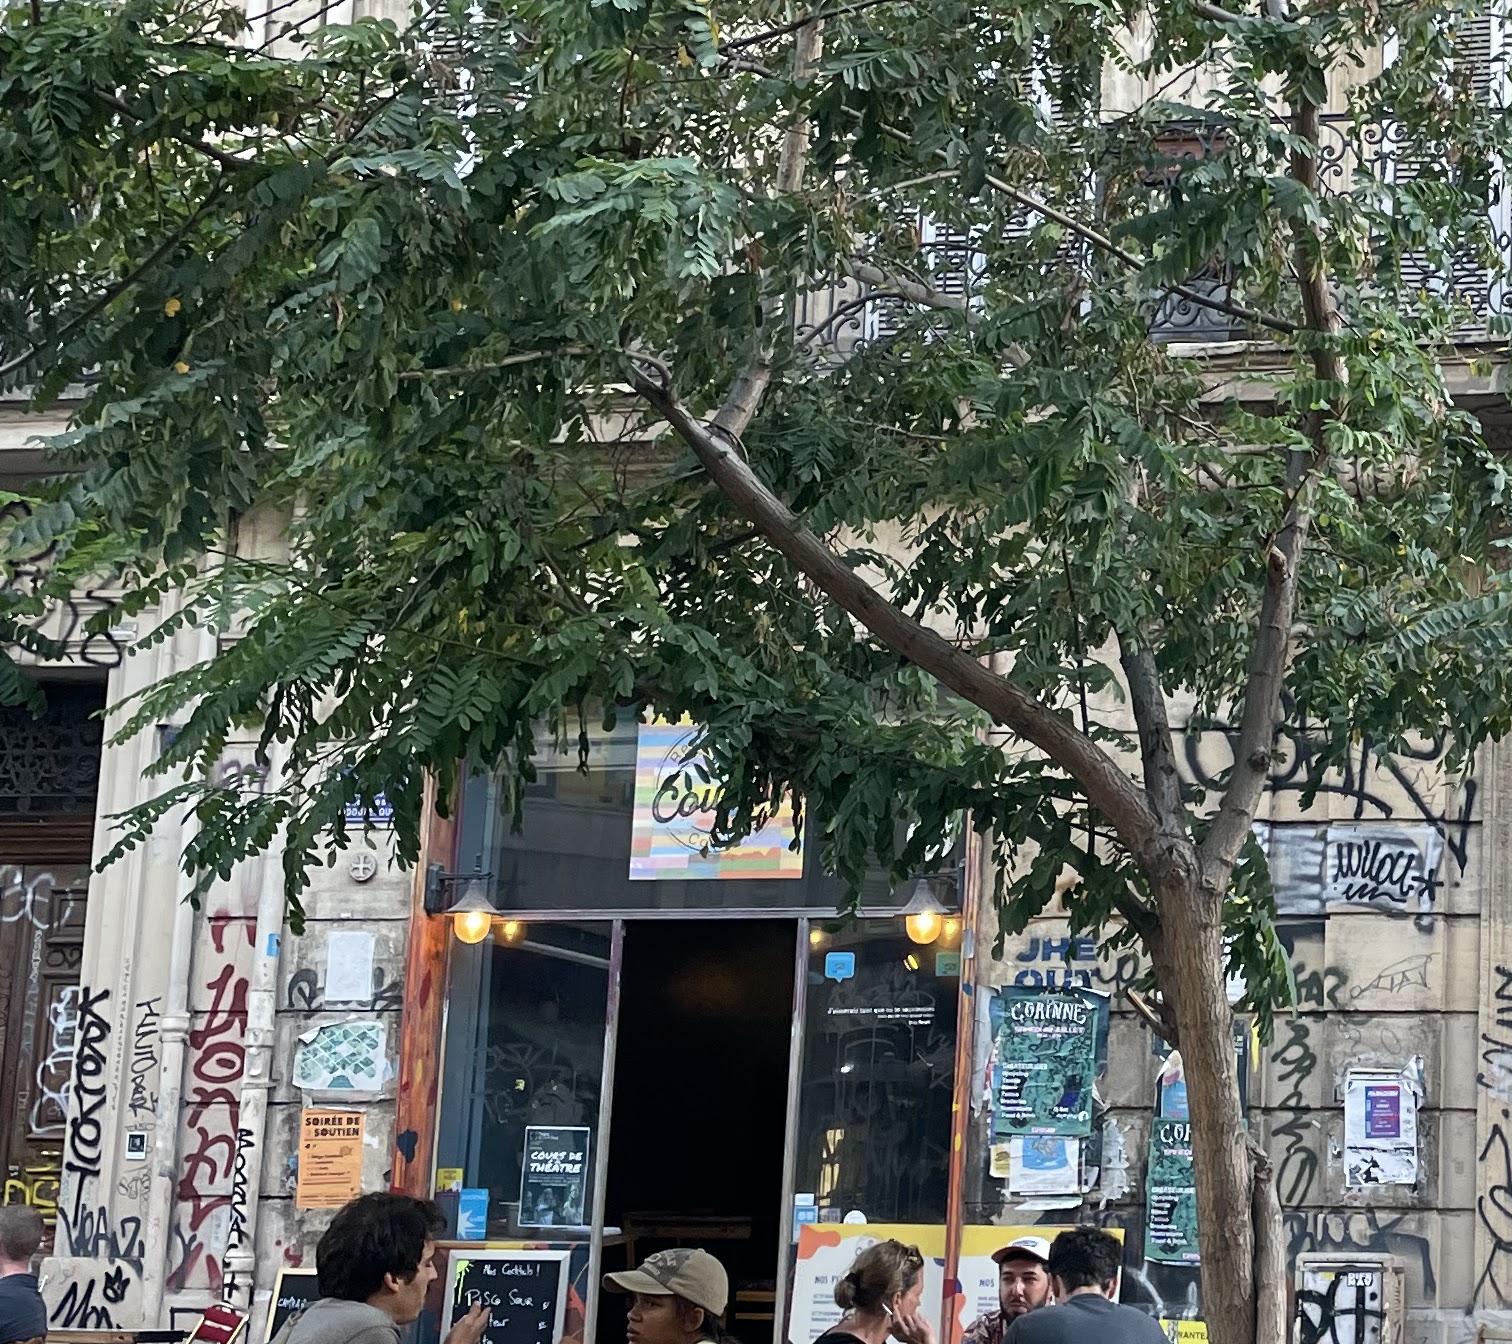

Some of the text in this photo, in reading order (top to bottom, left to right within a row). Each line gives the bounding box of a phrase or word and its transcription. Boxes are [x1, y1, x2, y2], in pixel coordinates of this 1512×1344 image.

[305, 1115, 361, 1126] SOIRÉE DE
[314, 1127, 360, 1137] SOUTIEN
[530, 1150, 584, 1161] COURS DE
[530, 1158, 582, 1173] THÉÂTRE
[979, 1278, 995, 1287] NOS
